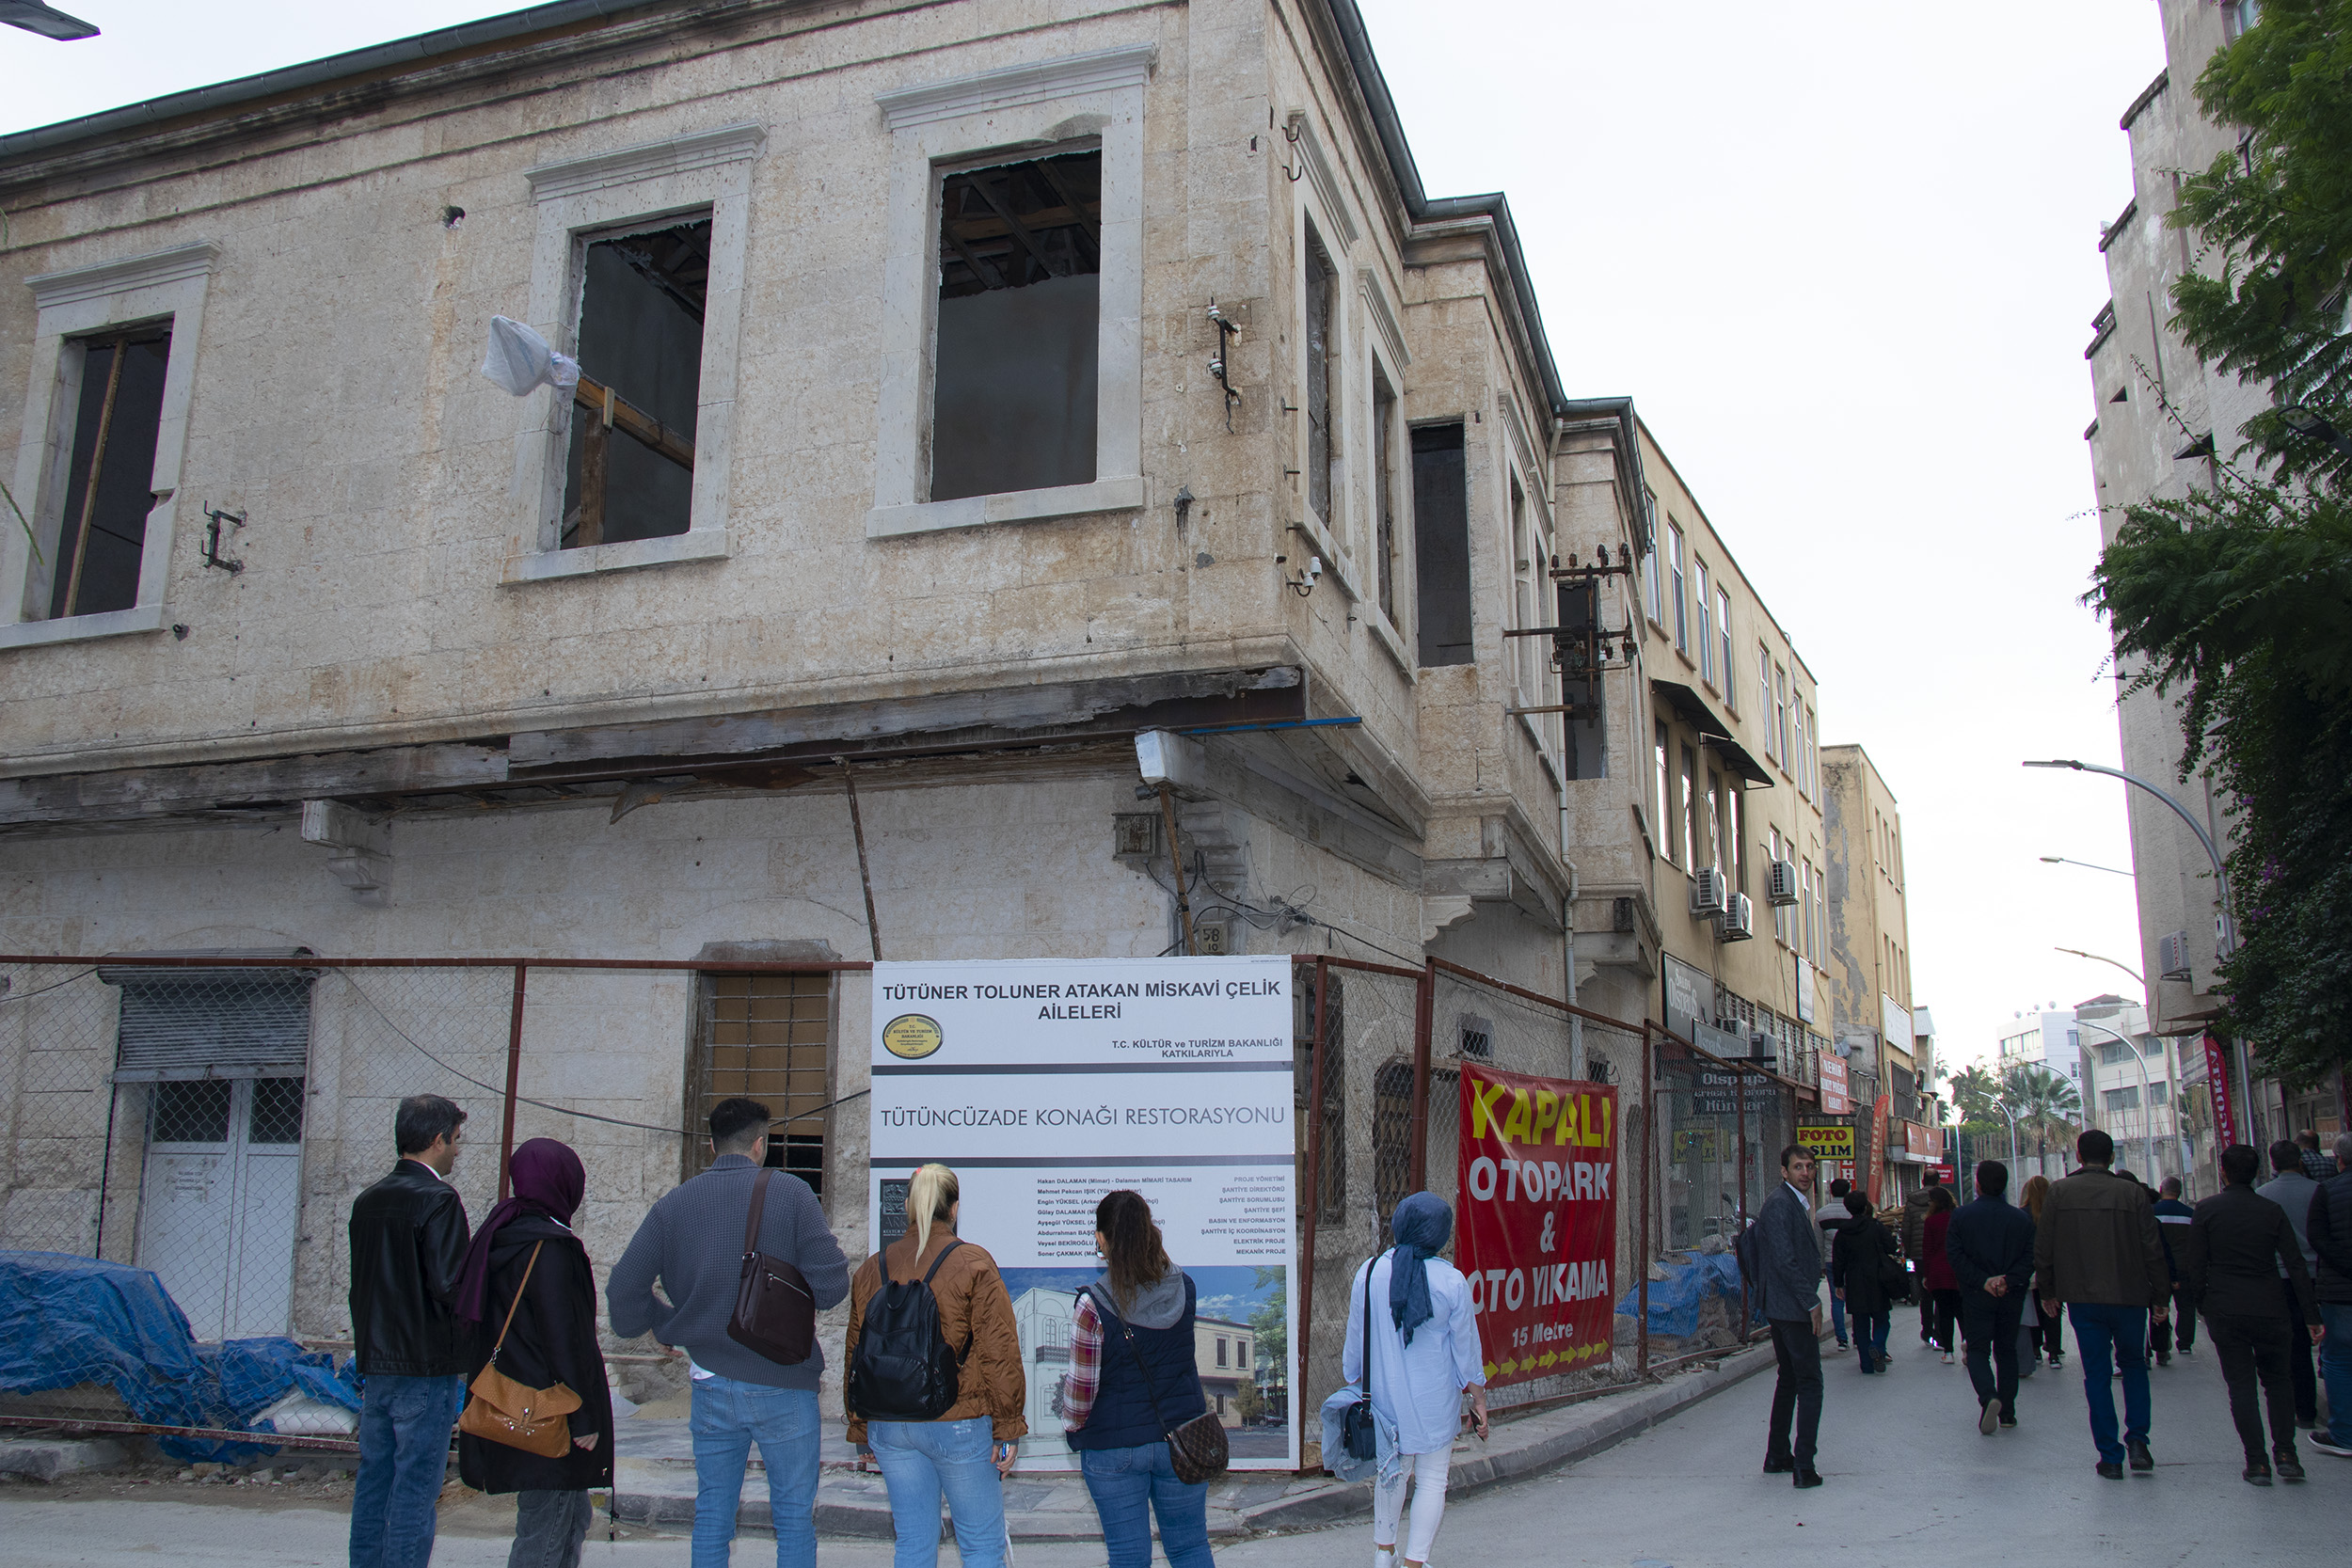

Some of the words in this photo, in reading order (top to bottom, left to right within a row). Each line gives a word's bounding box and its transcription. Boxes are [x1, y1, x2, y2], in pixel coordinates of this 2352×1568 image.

[882, 983, 968, 1000] TÜTÜNER
[974, 984, 1060, 999] TOLUNER
[1065, 983, 1139, 998] ATAKAN
[1145, 979, 1220, 997] MİSKAVİ
[1225, 978, 1281, 1000] ÇELİK
[1038, 1002, 1121, 1020] AİLELERİ
[1112, 1040, 1130, 1049] T.C.
[1133, 1038, 1172, 1048] KÜLTÜR
[1188, 1038, 1226, 1048] TURİZM
[1229, 1037, 1283, 1048] BAKANLIĞI
[1162, 1049, 1233, 1058] KATKILARIYLA
[1823, 1059, 1843, 1078] NEHİR
[881, 1106, 1028, 1127] TÜTÜNCÜZADE
[1036, 1105, 1118, 1126] KONAĞI
[1126, 1107, 1285, 1125] RESTORASYONU
[1471, 1079, 1612, 1148] KAPALI
[1798, 1130, 1848, 1142] FOTO
[1812, 1145, 1851, 1156] SLIM
[1469, 1156, 1612, 1203] OTOPARK
[1539, 1211, 1556, 1253] &
[1466, 1268, 1525, 1315] OTO
[1532, 1259, 1609, 1308] YIKAMA
[1512, 1325, 1529, 1348] 15
[1533, 1321, 1574, 1344] Metre
